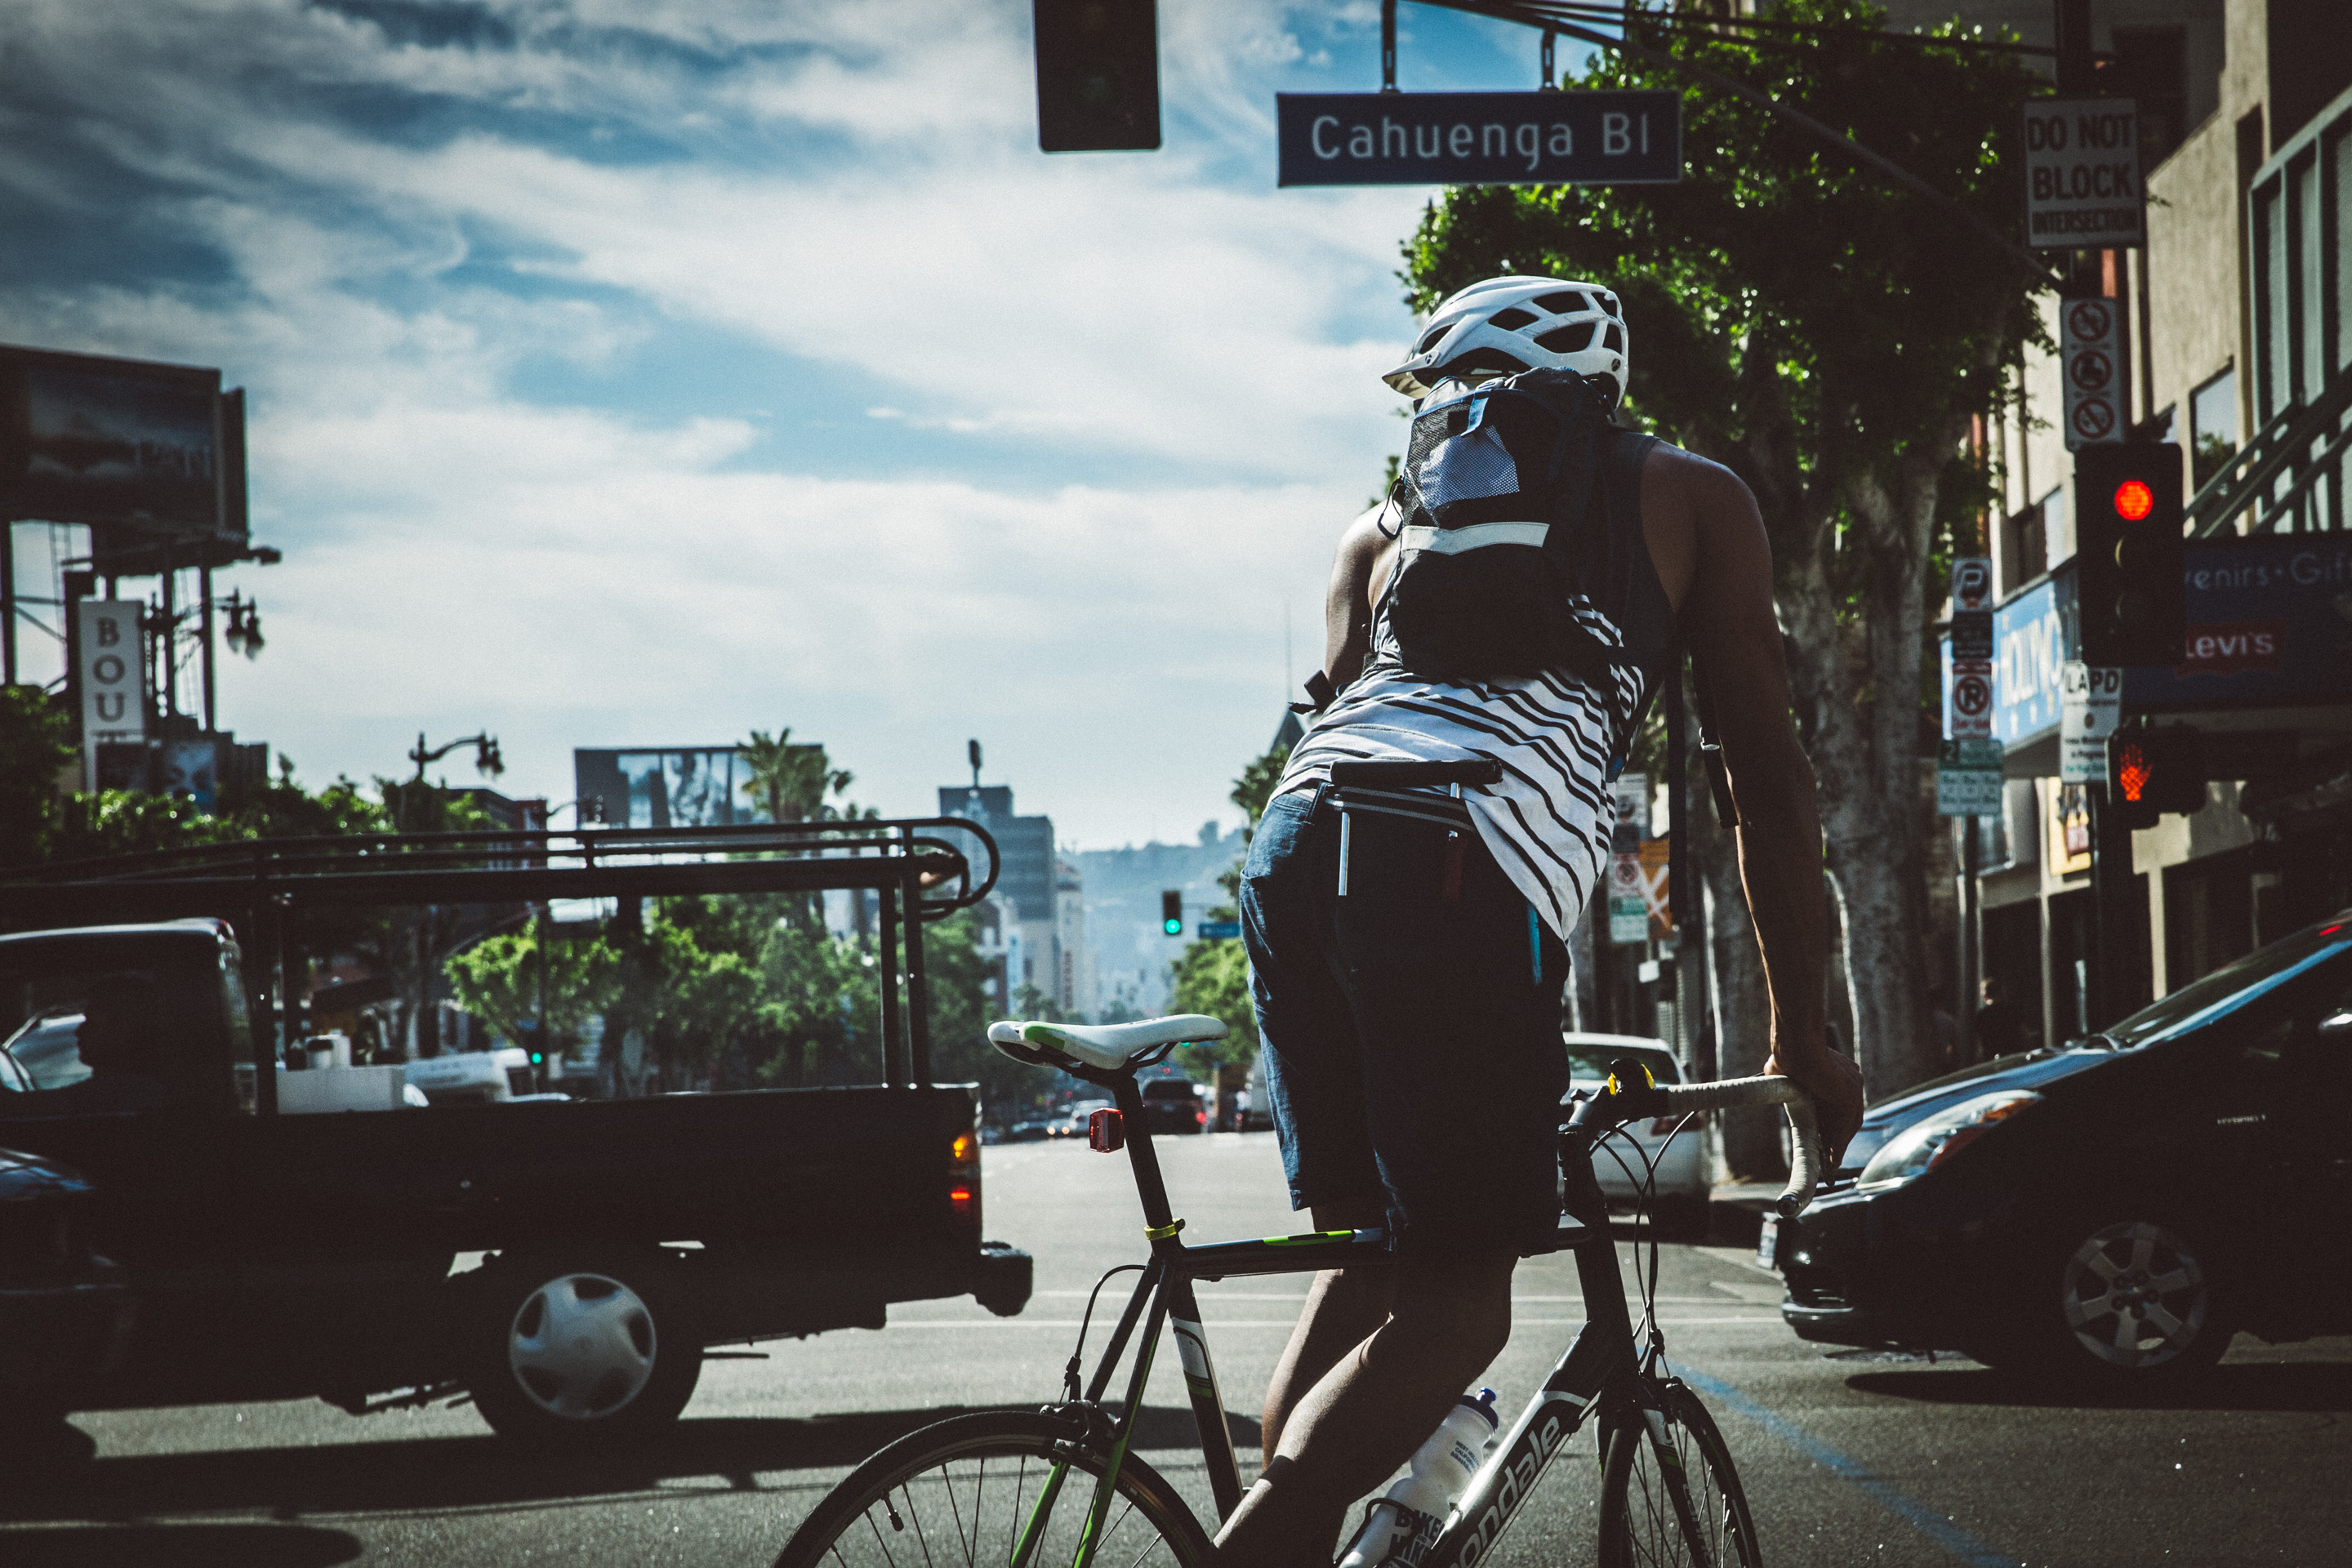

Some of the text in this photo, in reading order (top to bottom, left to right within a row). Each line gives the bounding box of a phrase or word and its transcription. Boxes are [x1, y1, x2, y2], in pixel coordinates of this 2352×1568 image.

[1311, 112, 1650, 172] Cahuenga Bl
[2027, 113, 2133, 152] DO NOT
[2033, 163, 2134, 200] BLOCK
[2032, 208, 2138, 234] INTERSECTION
[2289, 550, 2352, 585] Gif
[2066, 669, 2120, 693] LAPD
[1455, 1440, 1469, 1453] WEST
[1449, 1416, 1561, 1568] ondale
